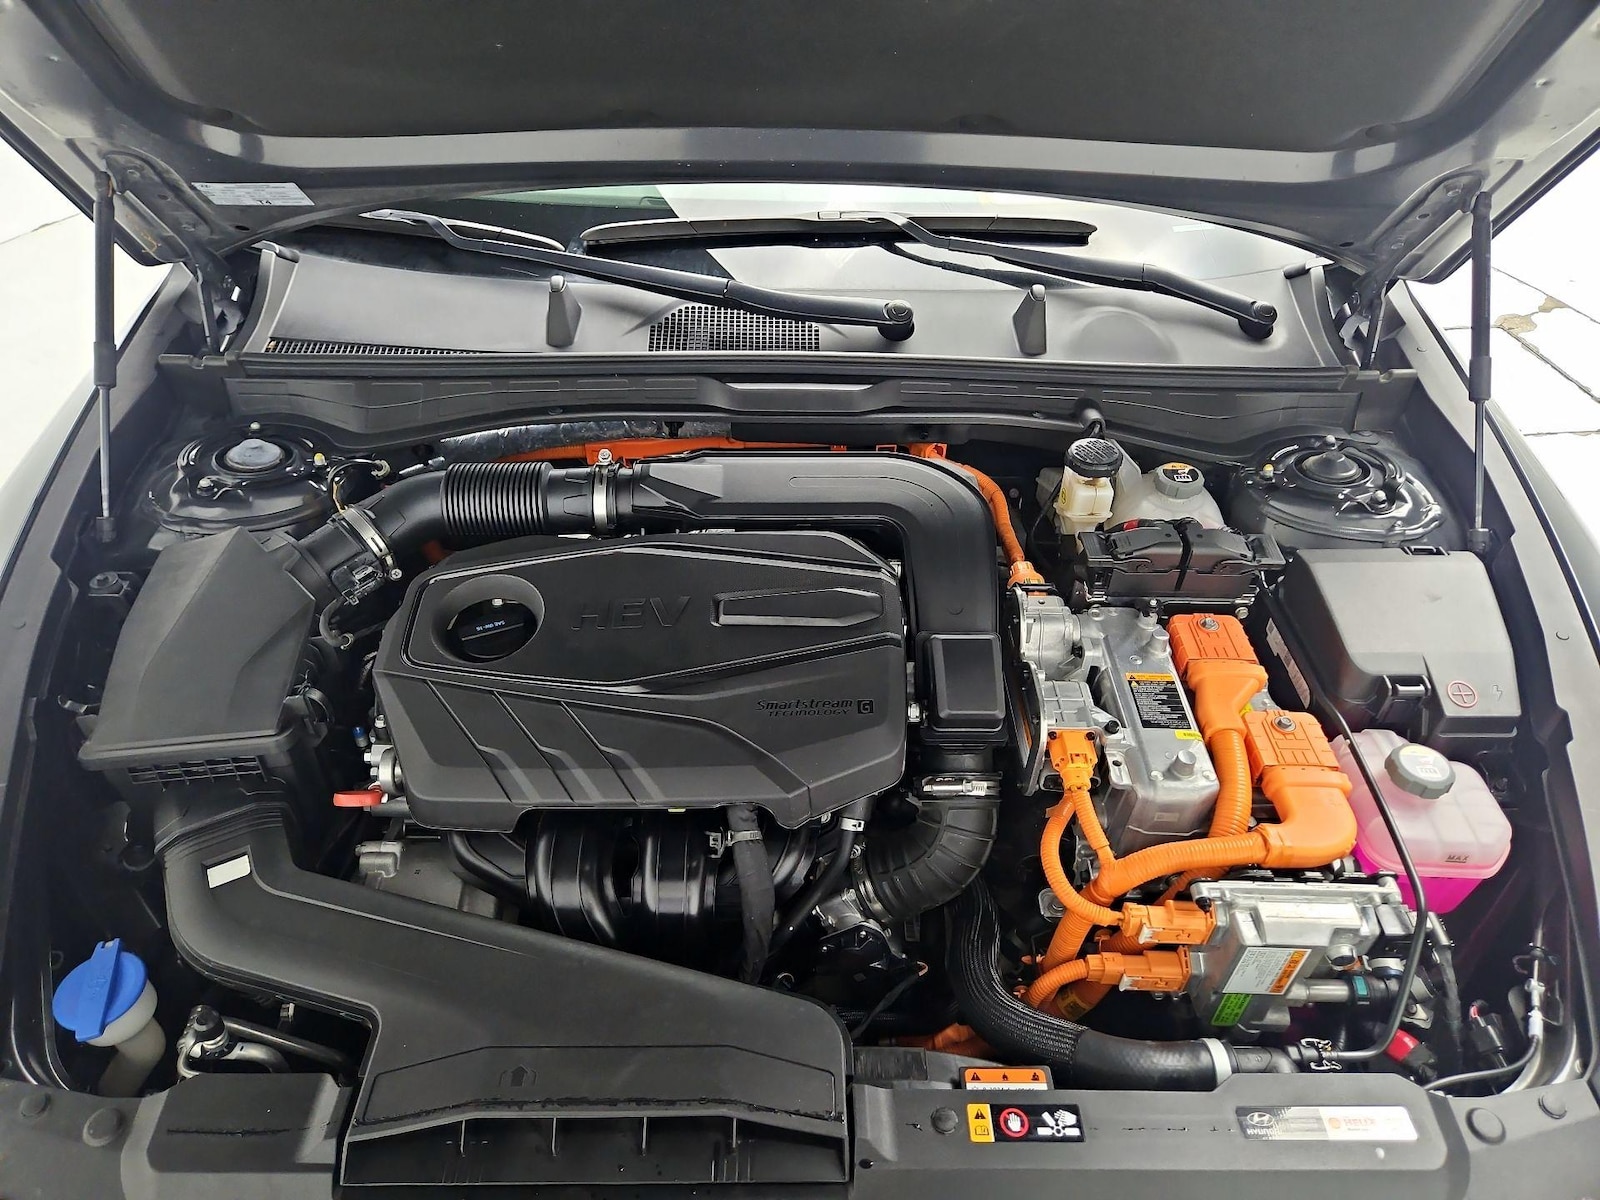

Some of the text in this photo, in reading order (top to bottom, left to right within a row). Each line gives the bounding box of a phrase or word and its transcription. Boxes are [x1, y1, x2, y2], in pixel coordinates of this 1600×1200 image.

[570, 595, 692, 631] HEV
[756, 699, 853, 711] Smartstream
[769, 708, 850, 717] TECHNOLOGY
